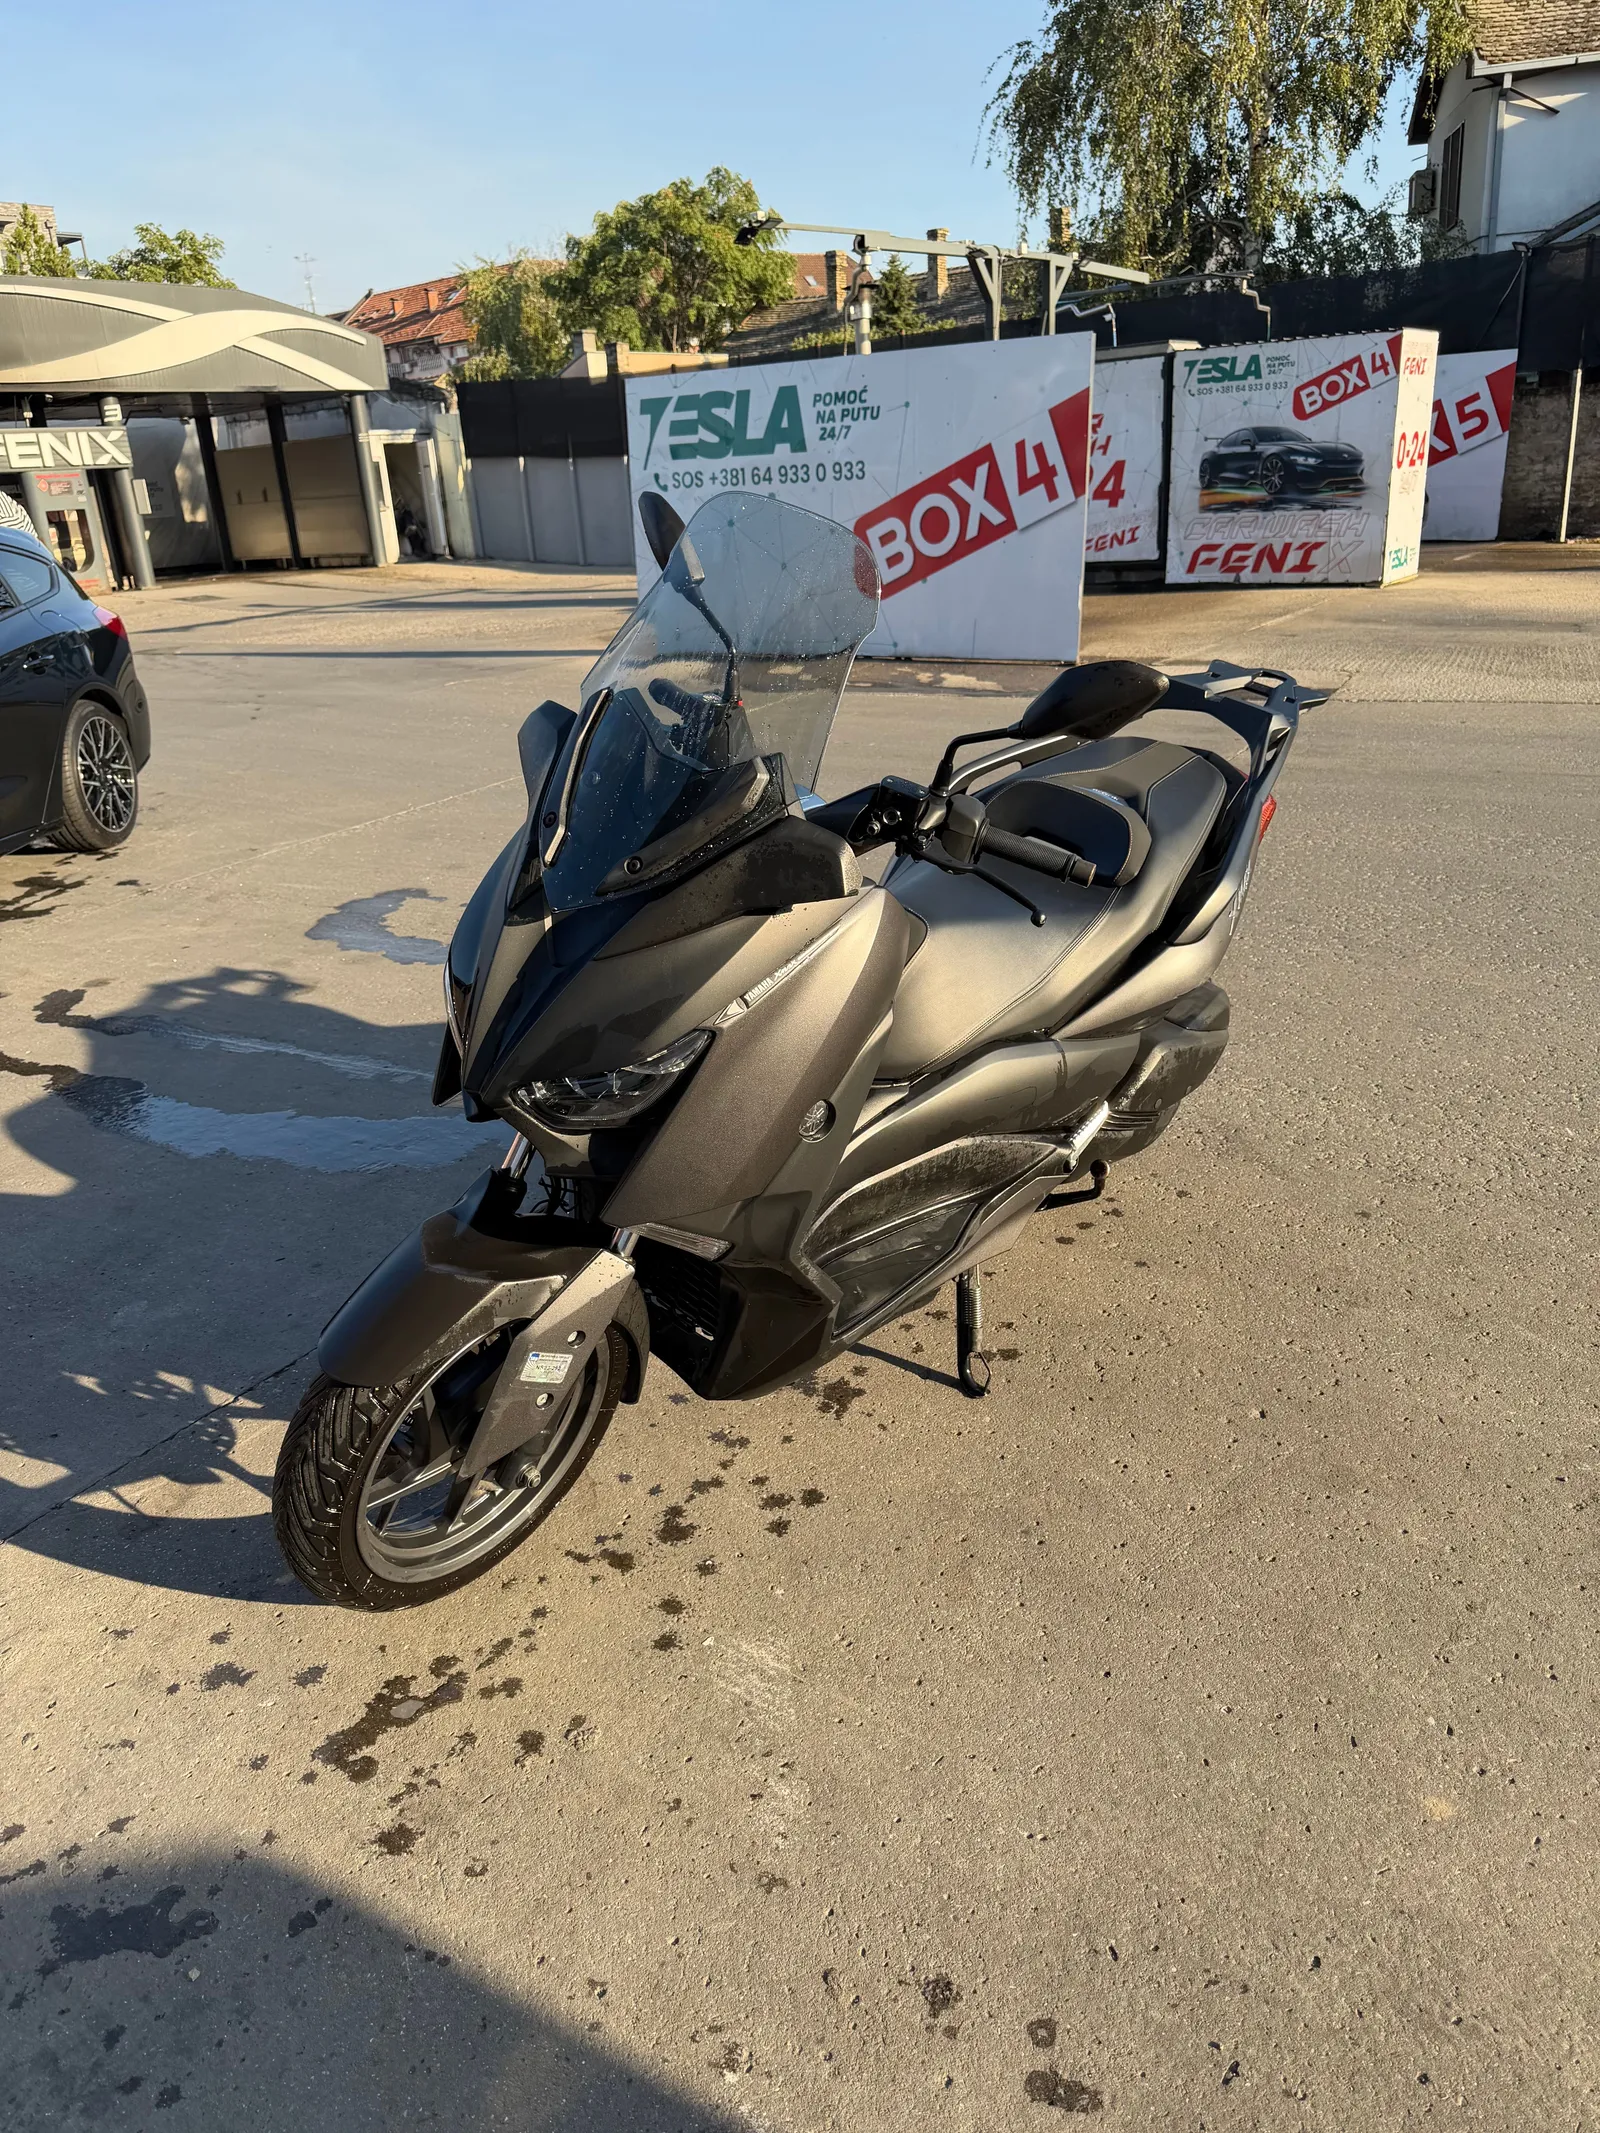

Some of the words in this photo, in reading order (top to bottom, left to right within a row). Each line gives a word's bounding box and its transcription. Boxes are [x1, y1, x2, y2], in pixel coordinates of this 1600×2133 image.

[1184, 354, 1263, 389] TESLA
[1300, 362, 1366, 414] BOX
[1371, 352, 1390, 377] 4
[812, 385, 868, 408] POMOĆ
[1197, 387, 1213, 396] SOS
[1215, 385, 1234, 394] +381
[1235, 384, 1246, 393] 64
[1248, 382, 1263, 392] 933
[1265, 382, 1271, 391] 0
[1272, 380, 1288, 390] 933
[639, 385, 807, 470] TESLA
[816, 410, 836, 425] NA
[840, 405, 881, 422] PUTU
[1455, 392, 1489, 441] 5
[819, 425, 851, 442] 24/7
[1396, 430, 1427, 469] 0-24
[672, 471, 704, 489] SOS
[709, 467, 746, 487] +381
[751, 466, 773, 485] 64
[778, 464, 810, 484] 933
[815, 463, 826, 482] 0
[832, 460, 866, 481] 933
[866, 461, 1007, 585] BOX
[1015, 438, 1059, 503] 4
[1183, 515, 1259, 540] CAR
[1262, 512, 1370, 538] WASH
[1186, 540, 1364, 574] FENIX
[744, 977, 774, 1002] YAMAHA
